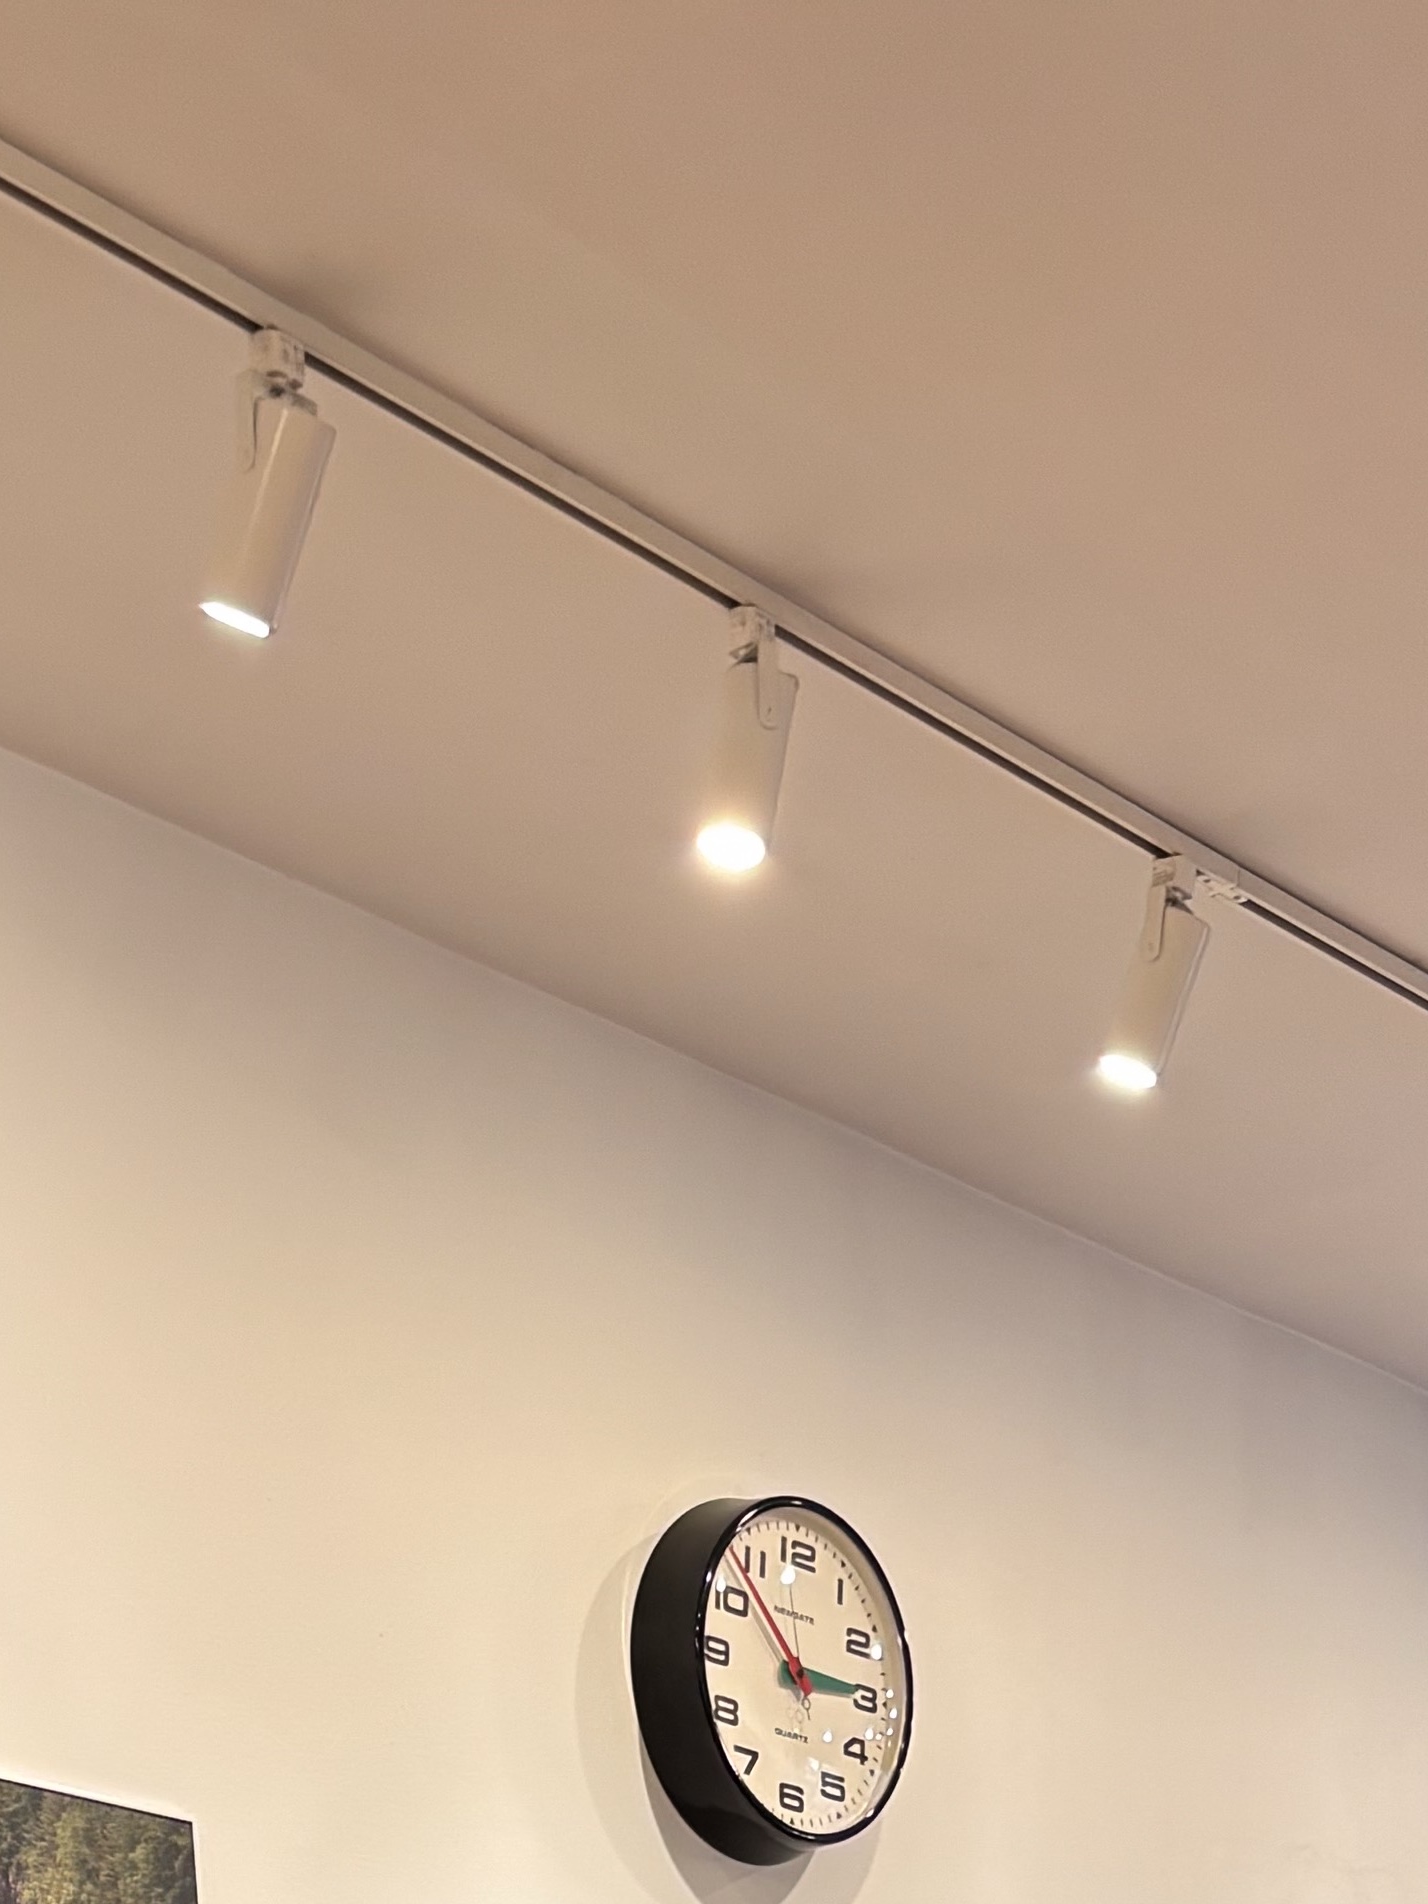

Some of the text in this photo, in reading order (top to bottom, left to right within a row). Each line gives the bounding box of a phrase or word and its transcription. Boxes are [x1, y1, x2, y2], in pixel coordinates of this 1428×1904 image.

[744, 1545, 766, 1579] 11
[781, 1536, 816, 1573] 12
[714, 1585, 749, 1618] 10
[837, 1578, 844, 1605] 1
[705, 1635, 730, 1666] 9
[846, 1627, 872, 1659] 2
[714, 1695, 739, 1726] 8
[854, 1683, 878, 1713] 3
[733, 1745, 759, 1776] 7
[843, 1737, 869, 1765] 4
[779, 1783, 805, 1813] 6
[821, 1771, 846, 1802] 5
